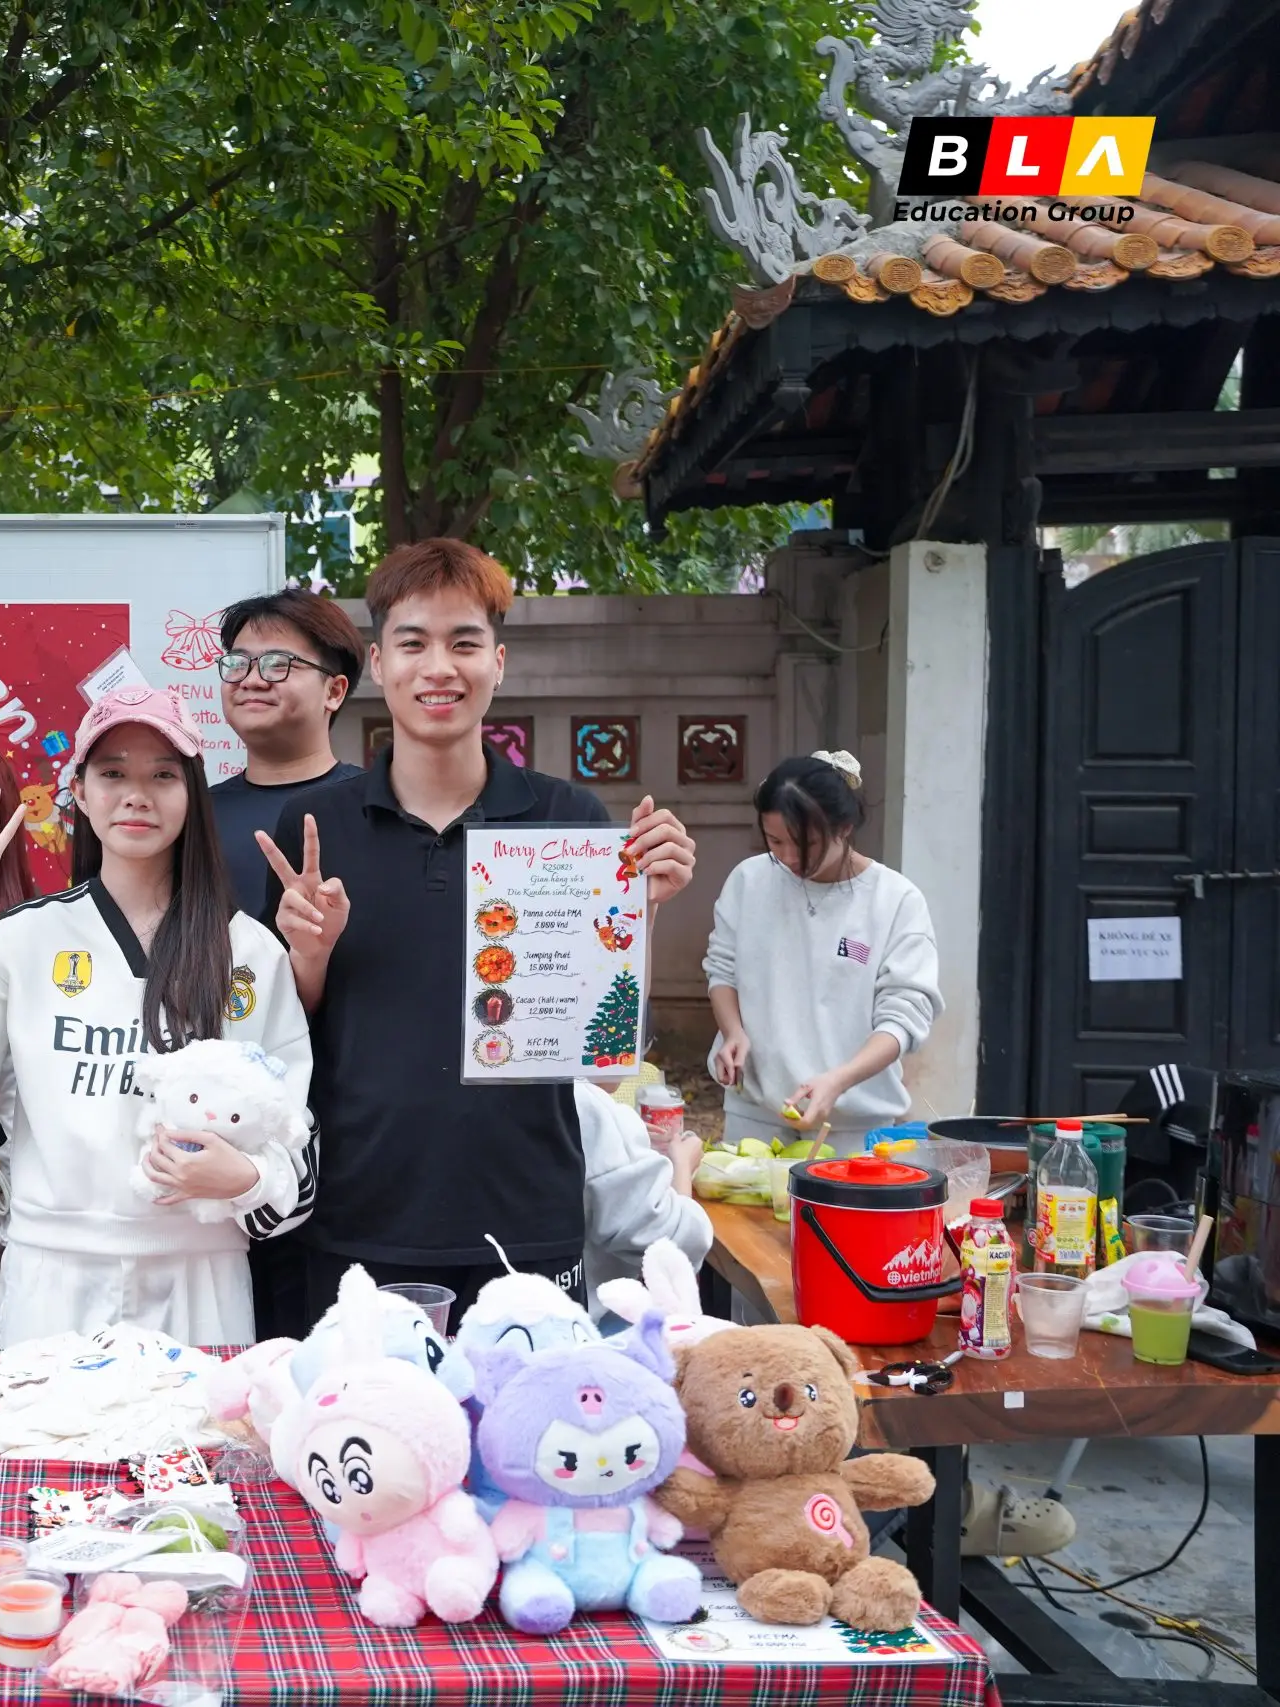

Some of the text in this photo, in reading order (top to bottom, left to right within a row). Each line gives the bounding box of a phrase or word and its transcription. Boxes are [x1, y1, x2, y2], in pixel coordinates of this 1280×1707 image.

[494, 839, 612, 868] Merry Christmas
[542, 863, 573, 871] K250825
[530, 875, 548, 885] Gian
[522, 886, 550, 897] Kunden
[552, 885, 570, 895] sind
[523, 909, 582, 917] Panna cotta PMA
[524, 951, 571, 962] Jumping fruit
[527, 1037, 559, 1047] KFC PMA
[71, 1061, 116, 1096] FLY
